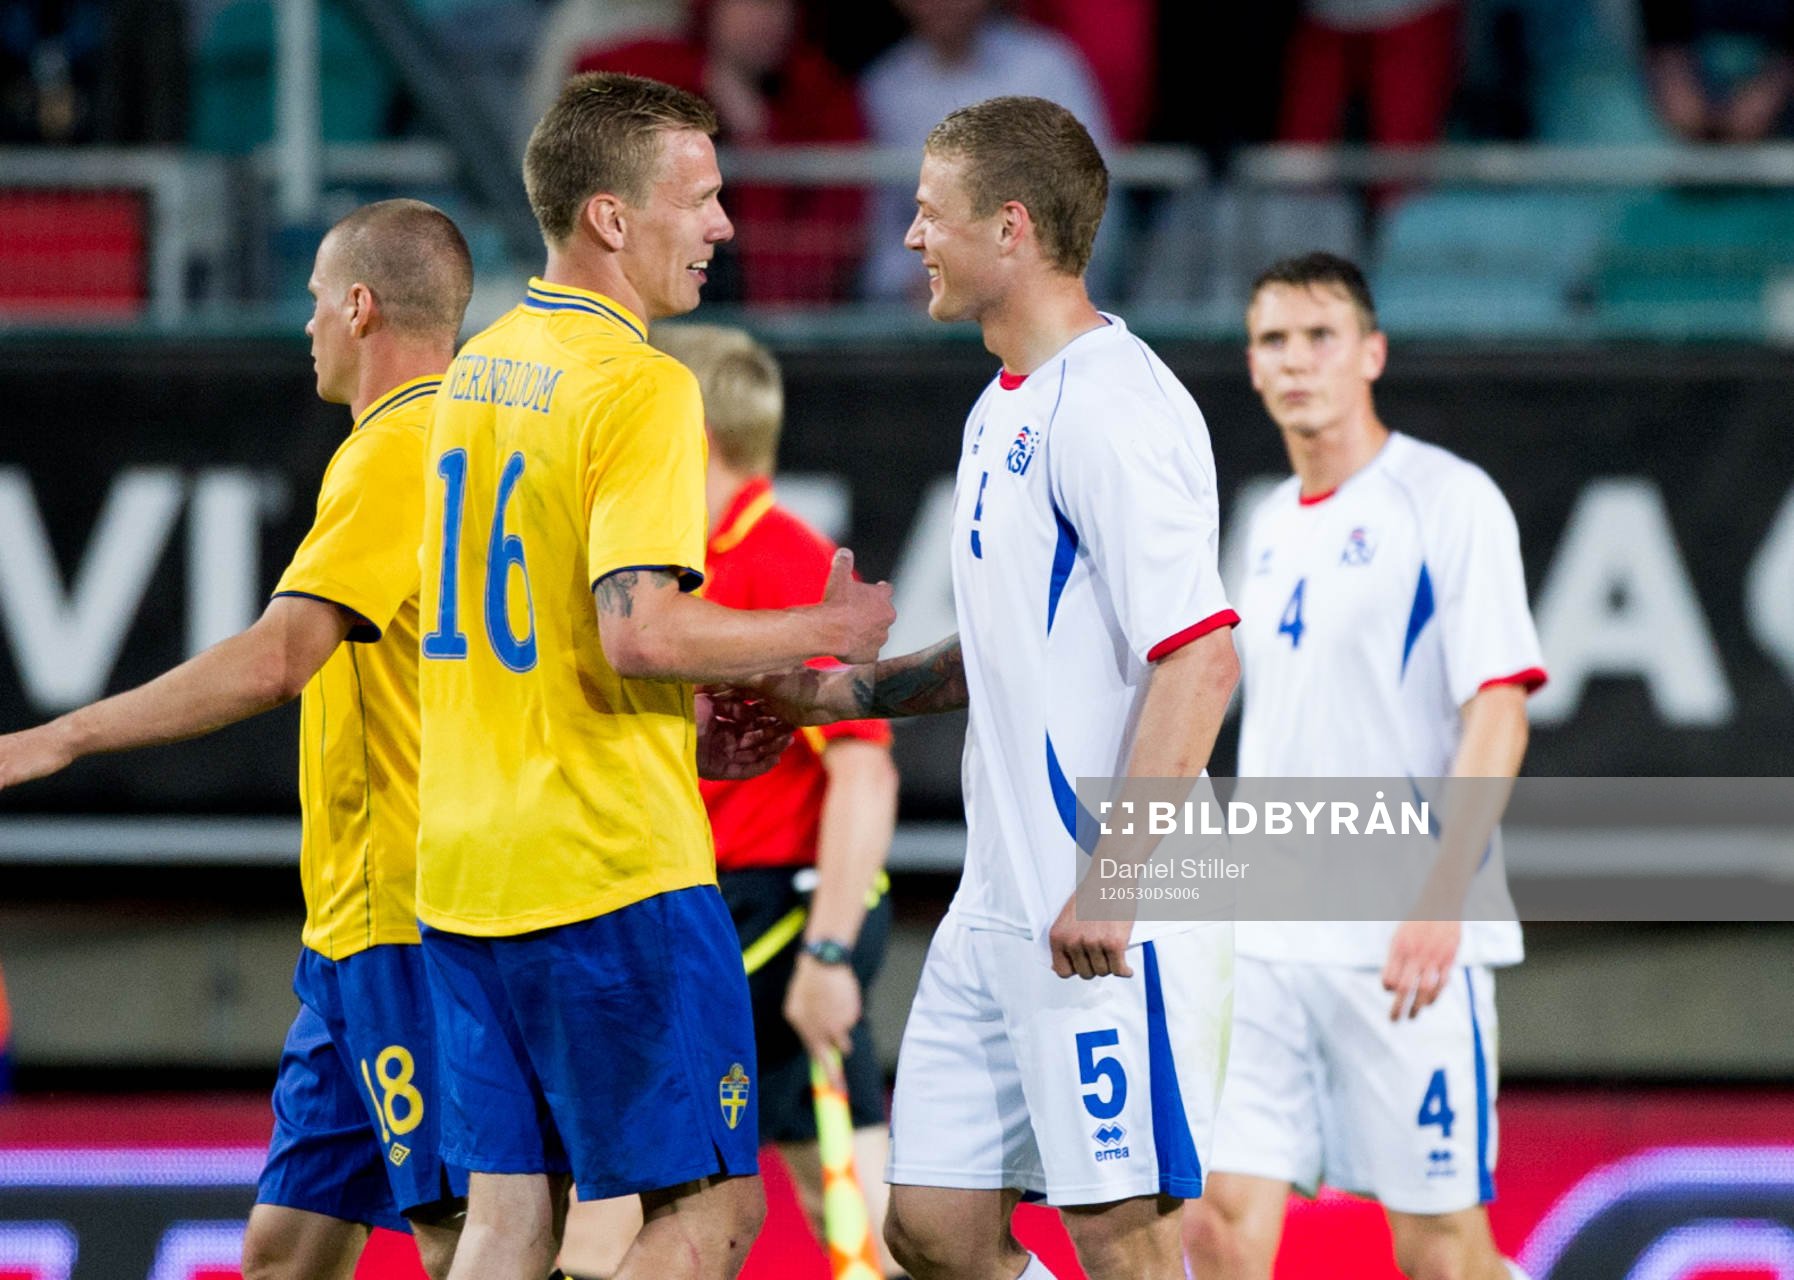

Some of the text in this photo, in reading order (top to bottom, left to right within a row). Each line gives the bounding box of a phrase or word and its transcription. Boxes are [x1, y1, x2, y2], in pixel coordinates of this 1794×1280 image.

[422, 448, 538, 673] 16
[1278, 577, 1306, 648] 4
[361, 1045, 424, 1143] 18
[1075, 1029, 1127, 1119] 5
[1418, 1069, 1454, 1137] 4
